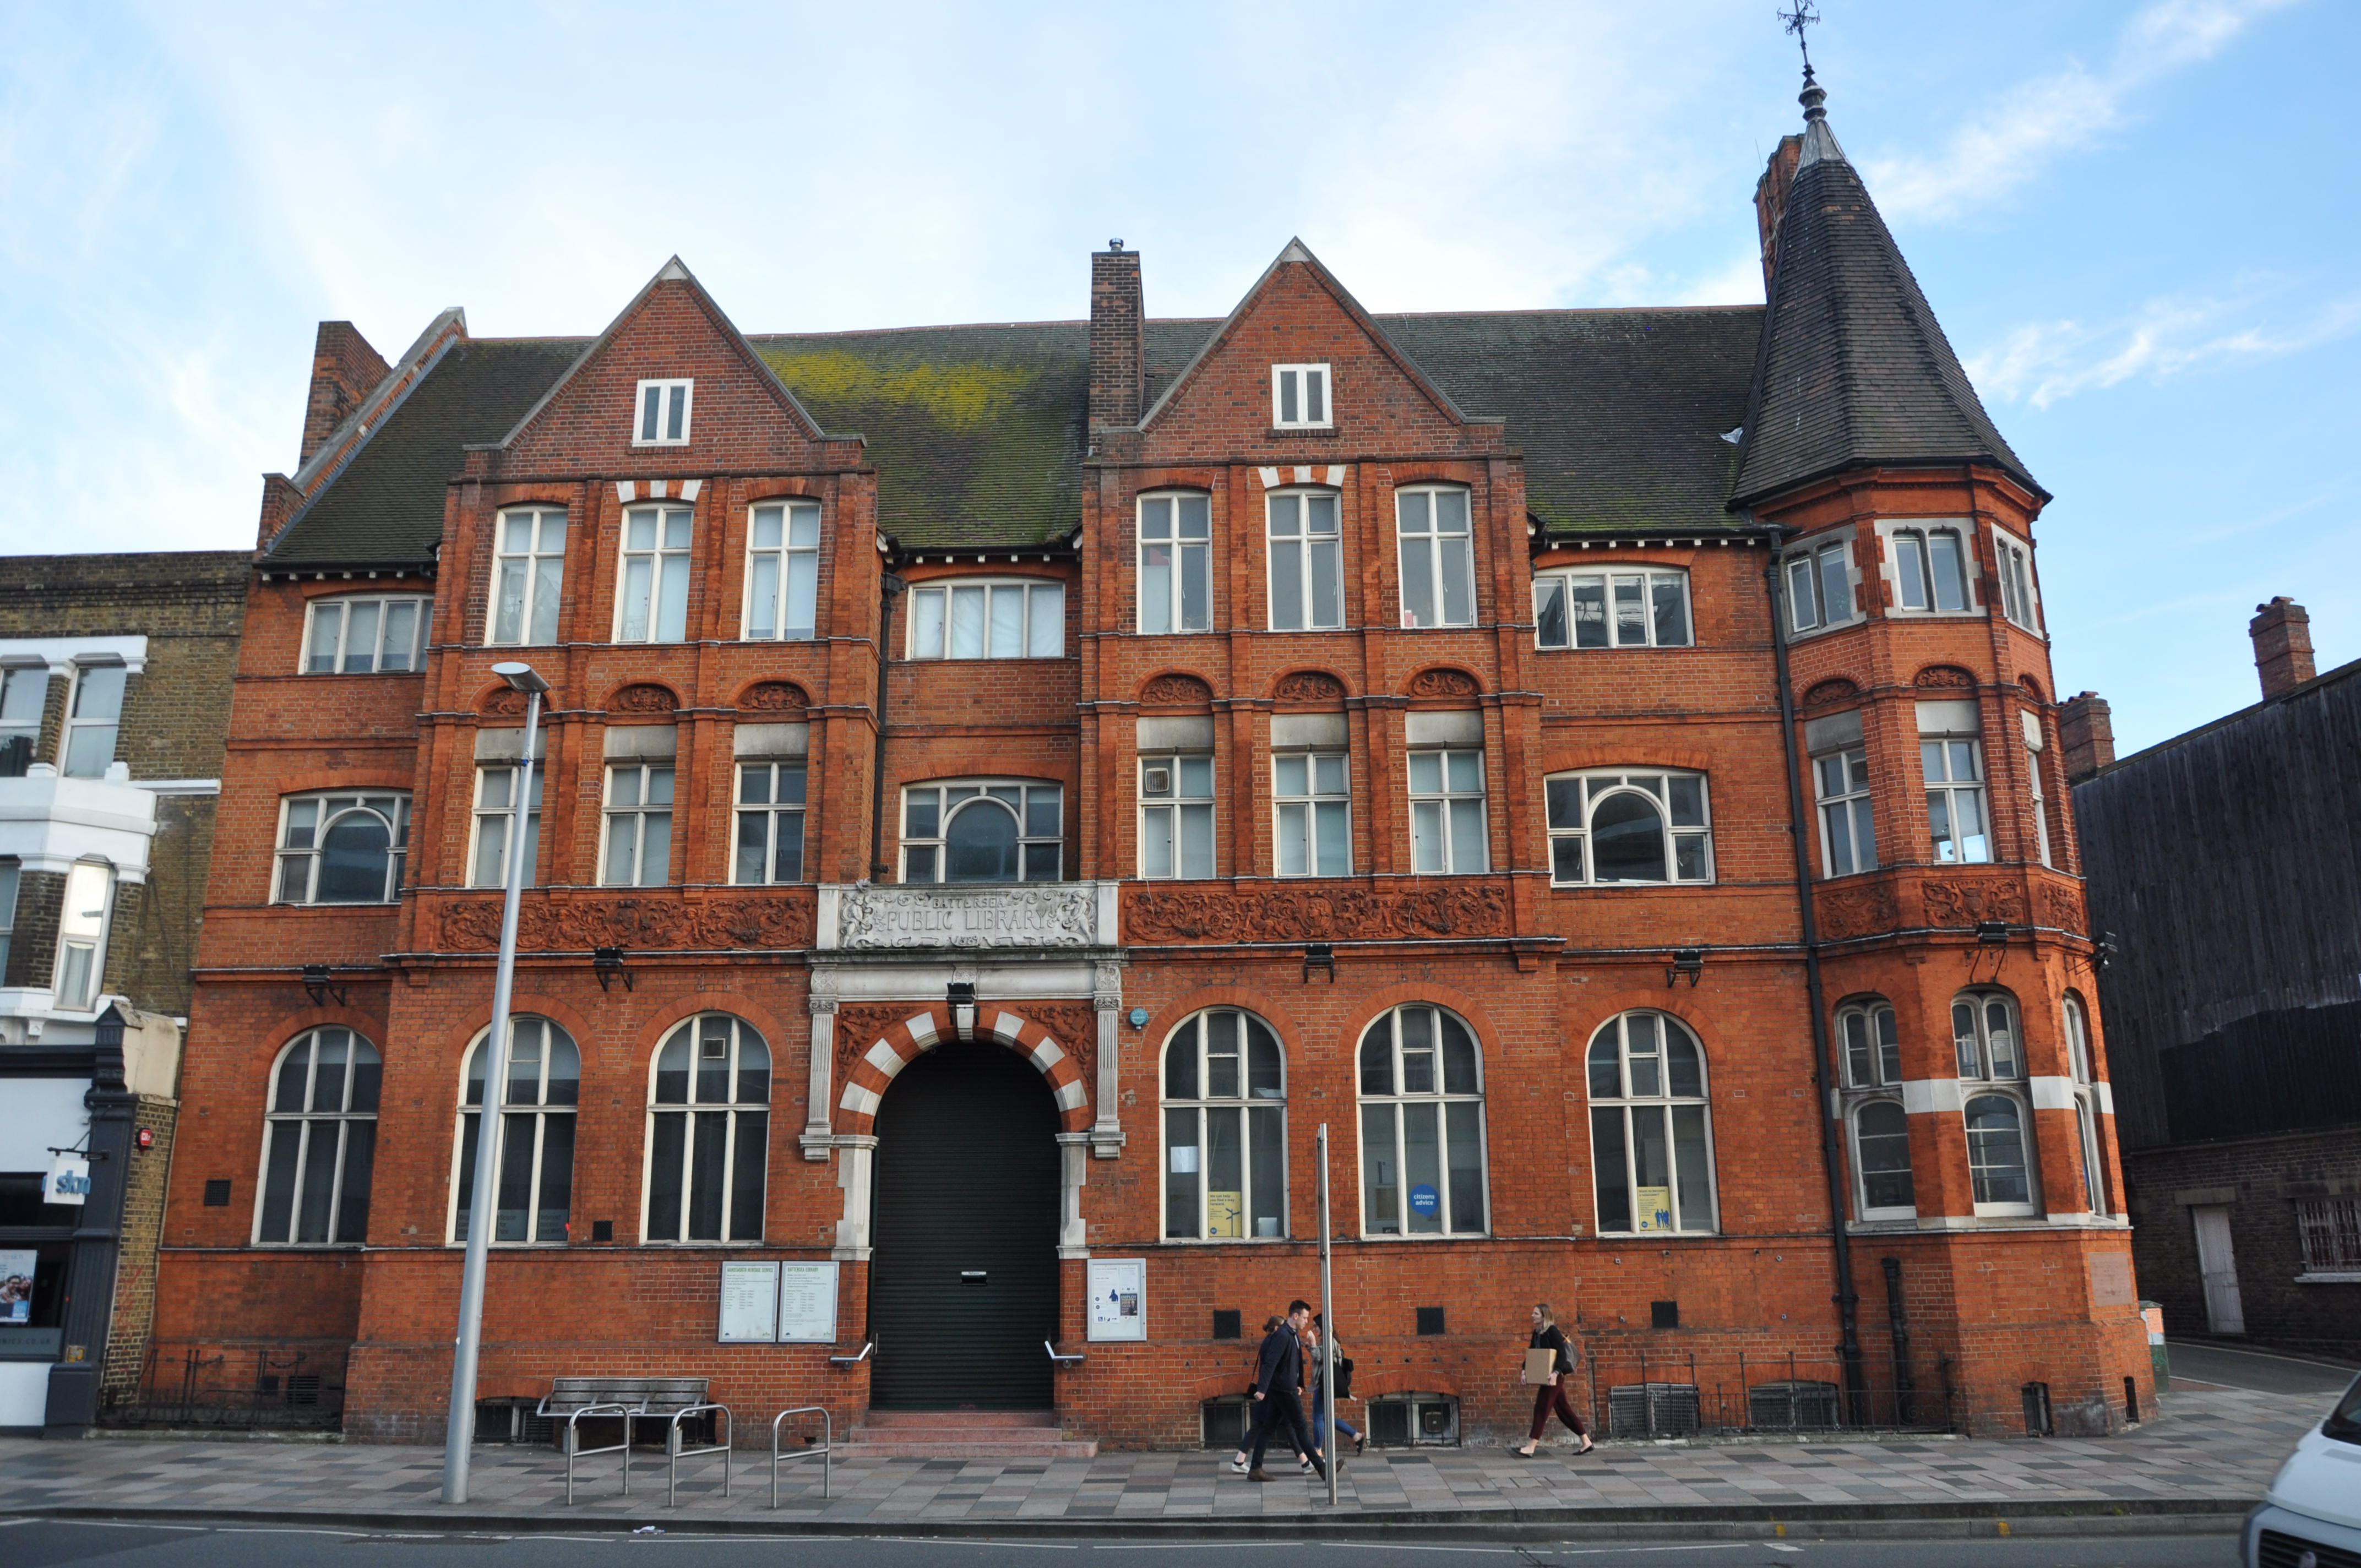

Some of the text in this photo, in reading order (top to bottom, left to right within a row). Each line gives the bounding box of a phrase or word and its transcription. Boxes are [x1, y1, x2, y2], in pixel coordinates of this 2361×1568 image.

[933, 899, 1005, 909] BATTERSEA
[887, 910, 1047, 931] PUBLIC LIBRARY
[954, 935, 978, 946] 1889
